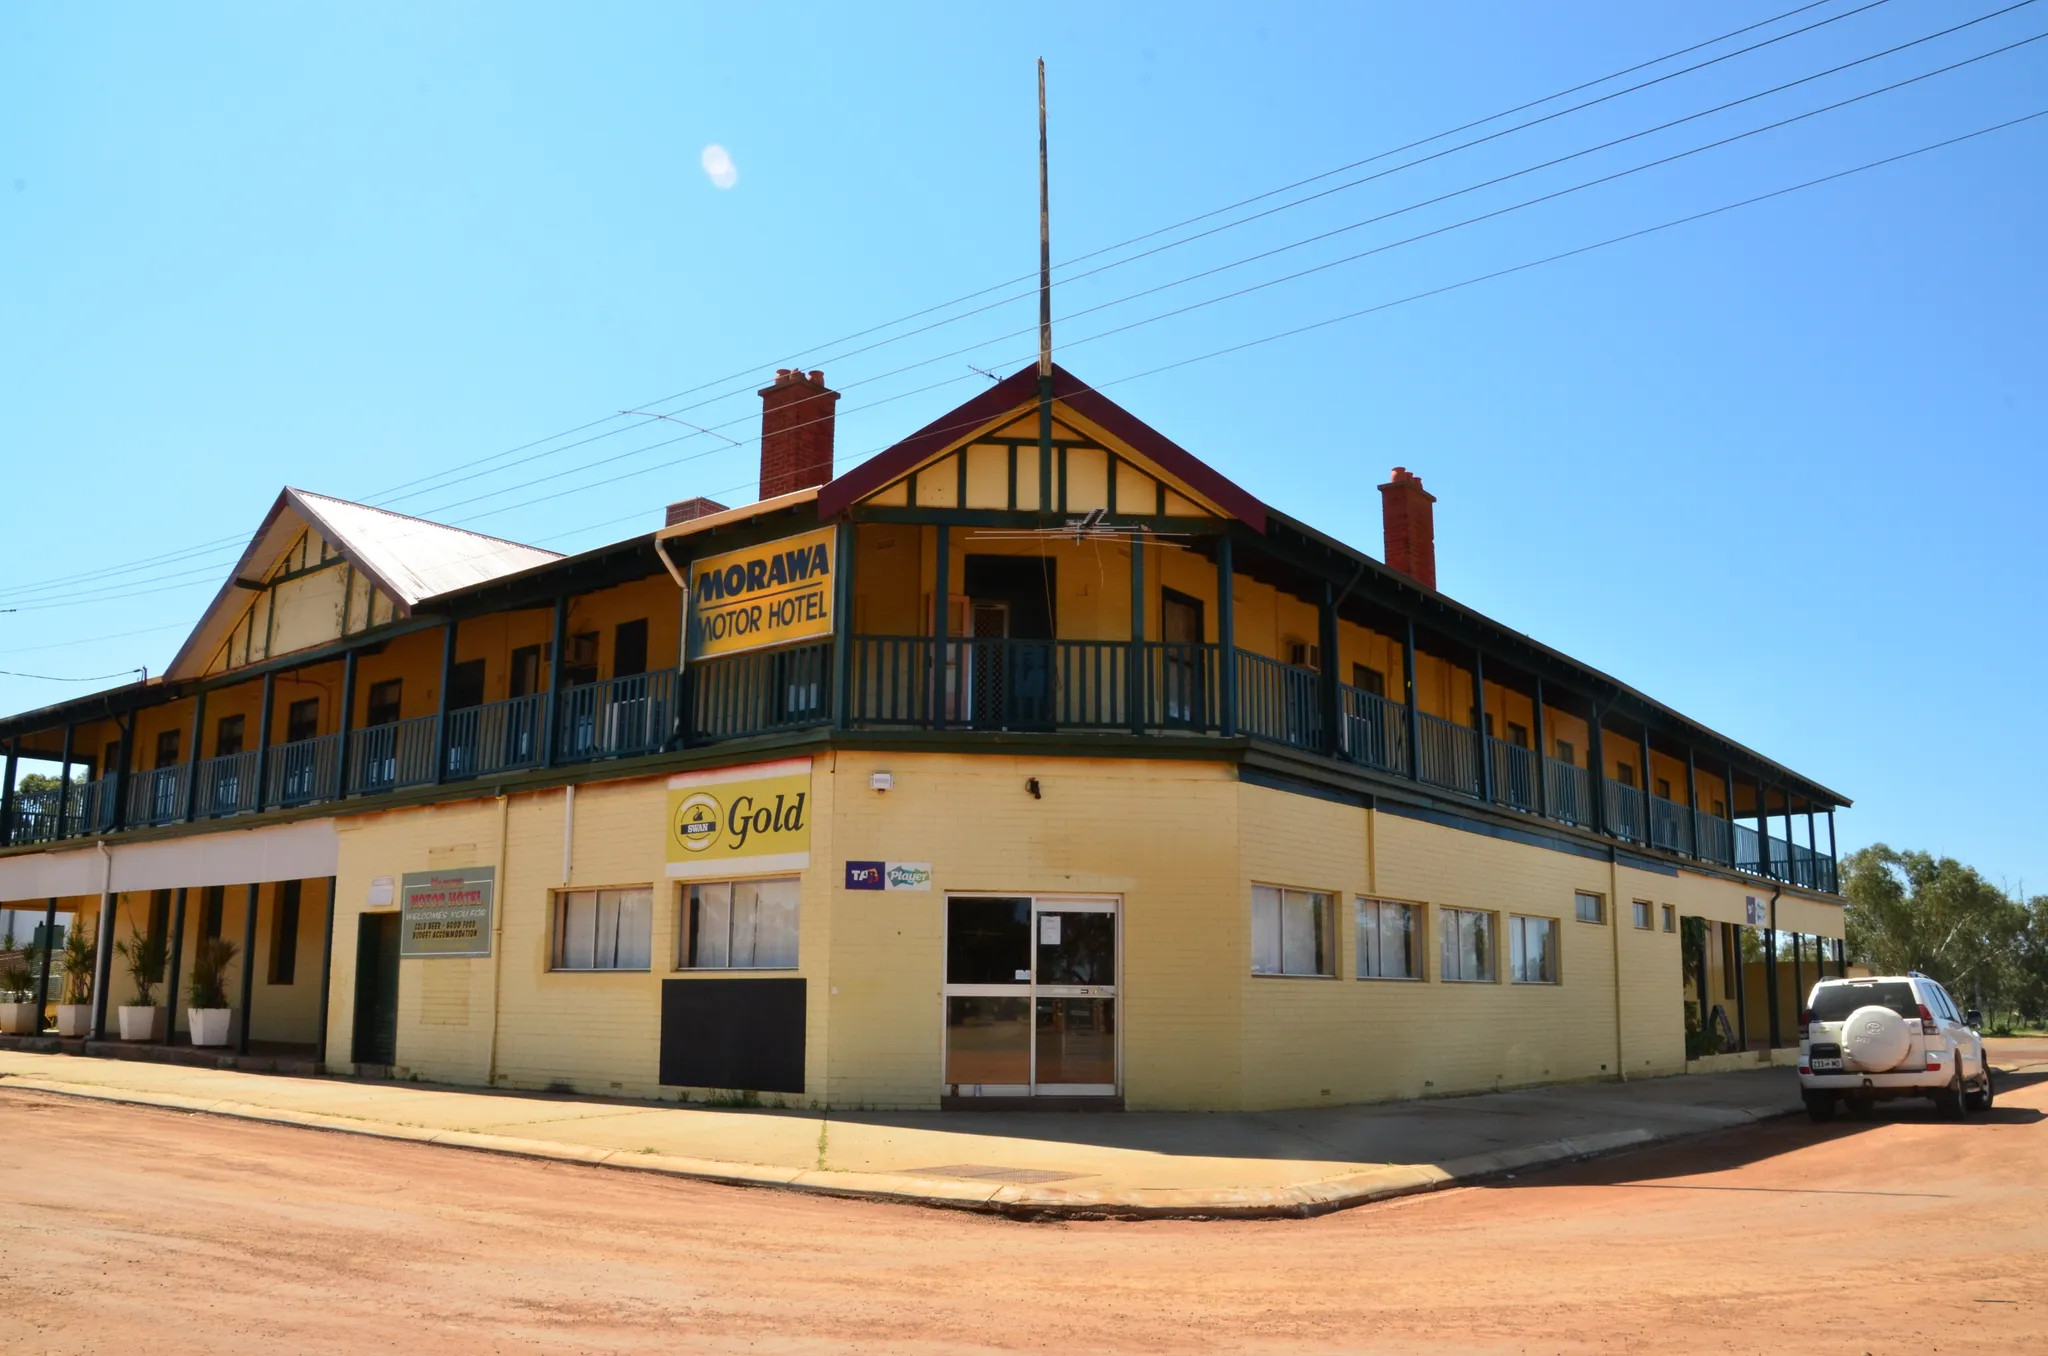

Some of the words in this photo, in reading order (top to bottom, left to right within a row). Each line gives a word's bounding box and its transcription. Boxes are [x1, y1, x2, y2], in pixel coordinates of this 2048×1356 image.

[696, 543, 830, 604] MORAWA
[697, 605, 762, 644] MOTOR
[768, 591, 827, 629] HOTEL
[687, 823, 709, 833] SWAN
[728, 792, 806, 850] Gold
[890, 870, 928, 883] Player
[410, 893, 446, 908] MOTOR
[448, 890, 482, 906] HOTEL
[406, 910, 448, 921] WELCOMES
[451, 909, 468, 919] YOU
[470, 909, 487, 917] FOR
[446, 921, 462, 929] GOOD
[463, 920, 476, 929] FOOD
